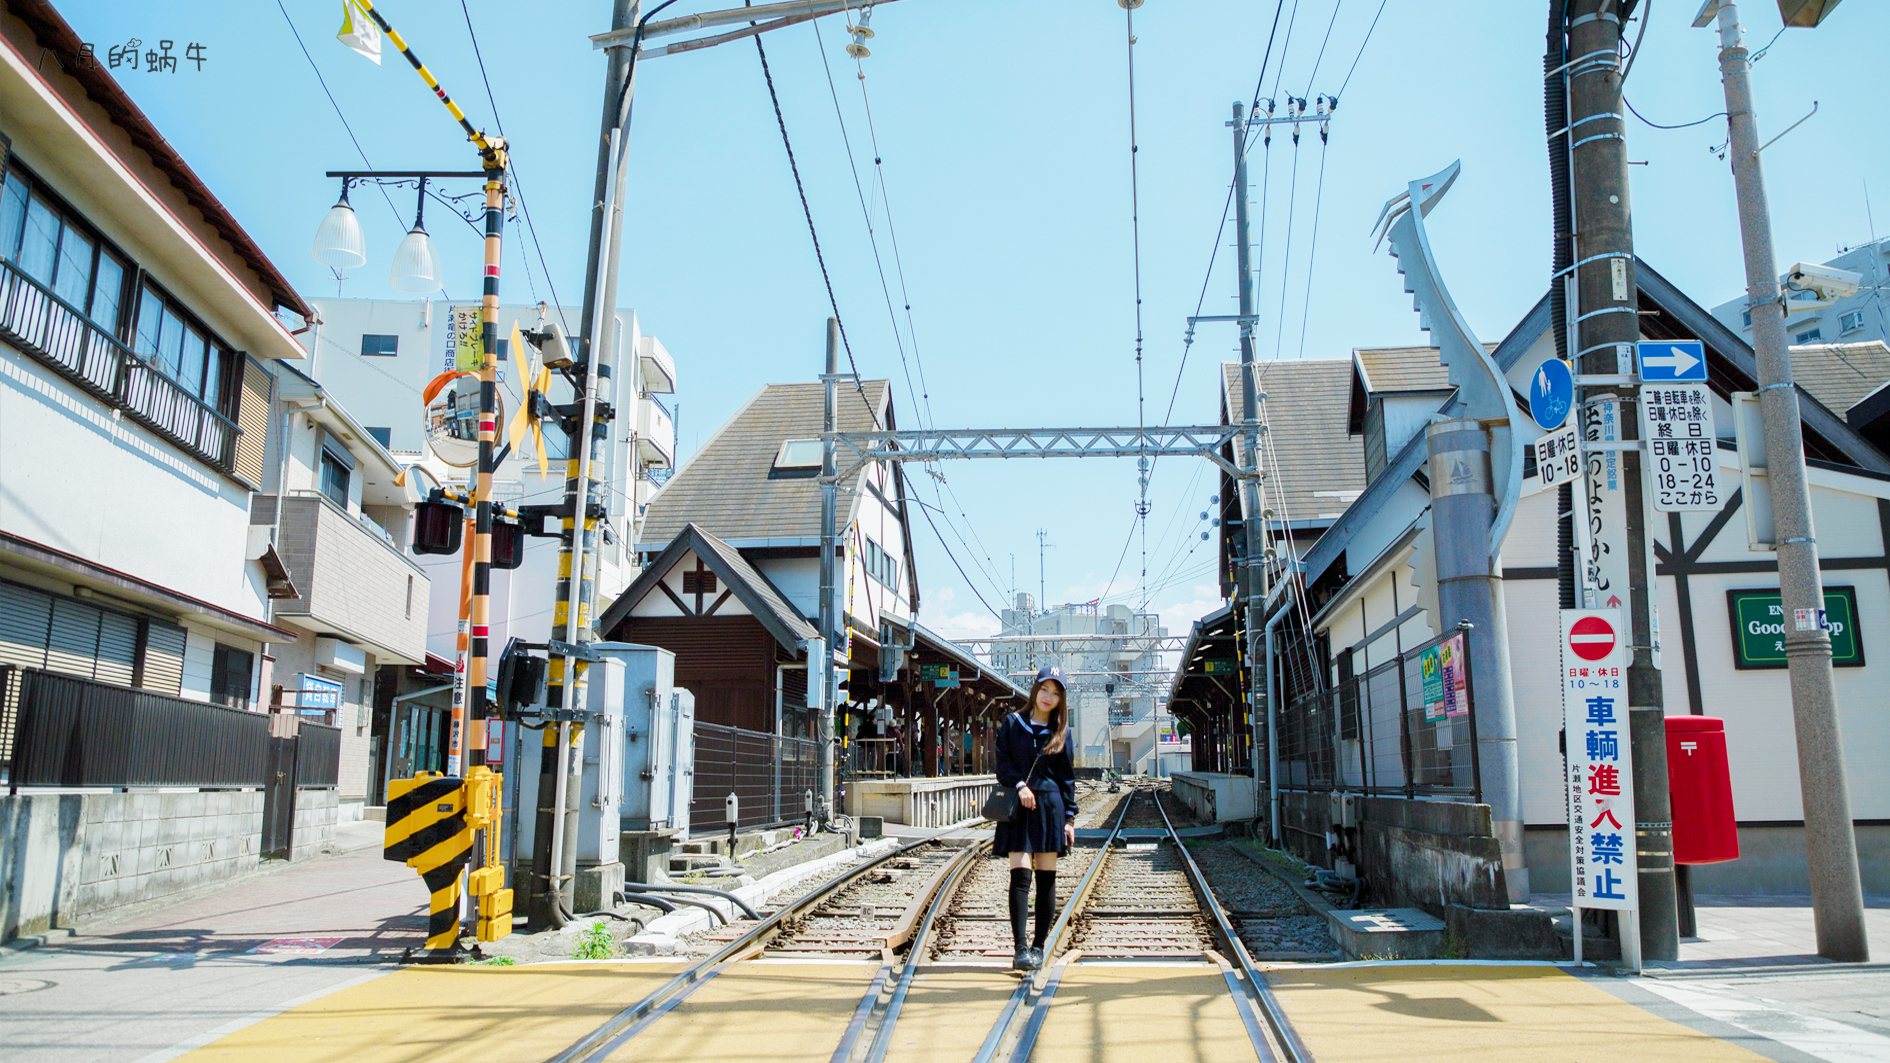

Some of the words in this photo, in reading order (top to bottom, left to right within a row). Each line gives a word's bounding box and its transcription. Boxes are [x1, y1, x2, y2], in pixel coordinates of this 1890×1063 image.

[469, 311, 479, 367] サイドブレーキ
[1646, 390, 1707, 405] 二輪・自転車を除く
[1649, 406, 1708, 421] 日曜・休日を除く
[1539, 432, 1575, 462] 日曜・休日
[1653, 441, 1712, 456] 日曜・休日
[1660, 491, 1717, 505] ここから
[941, 668, 947, 676] 2
[1569, 668, 1619, 677] 日曜・休日
[453, 676, 464, 705] 注意
[1572, 764, 1586, 897] 片瀬地区交通安全対策協議会
